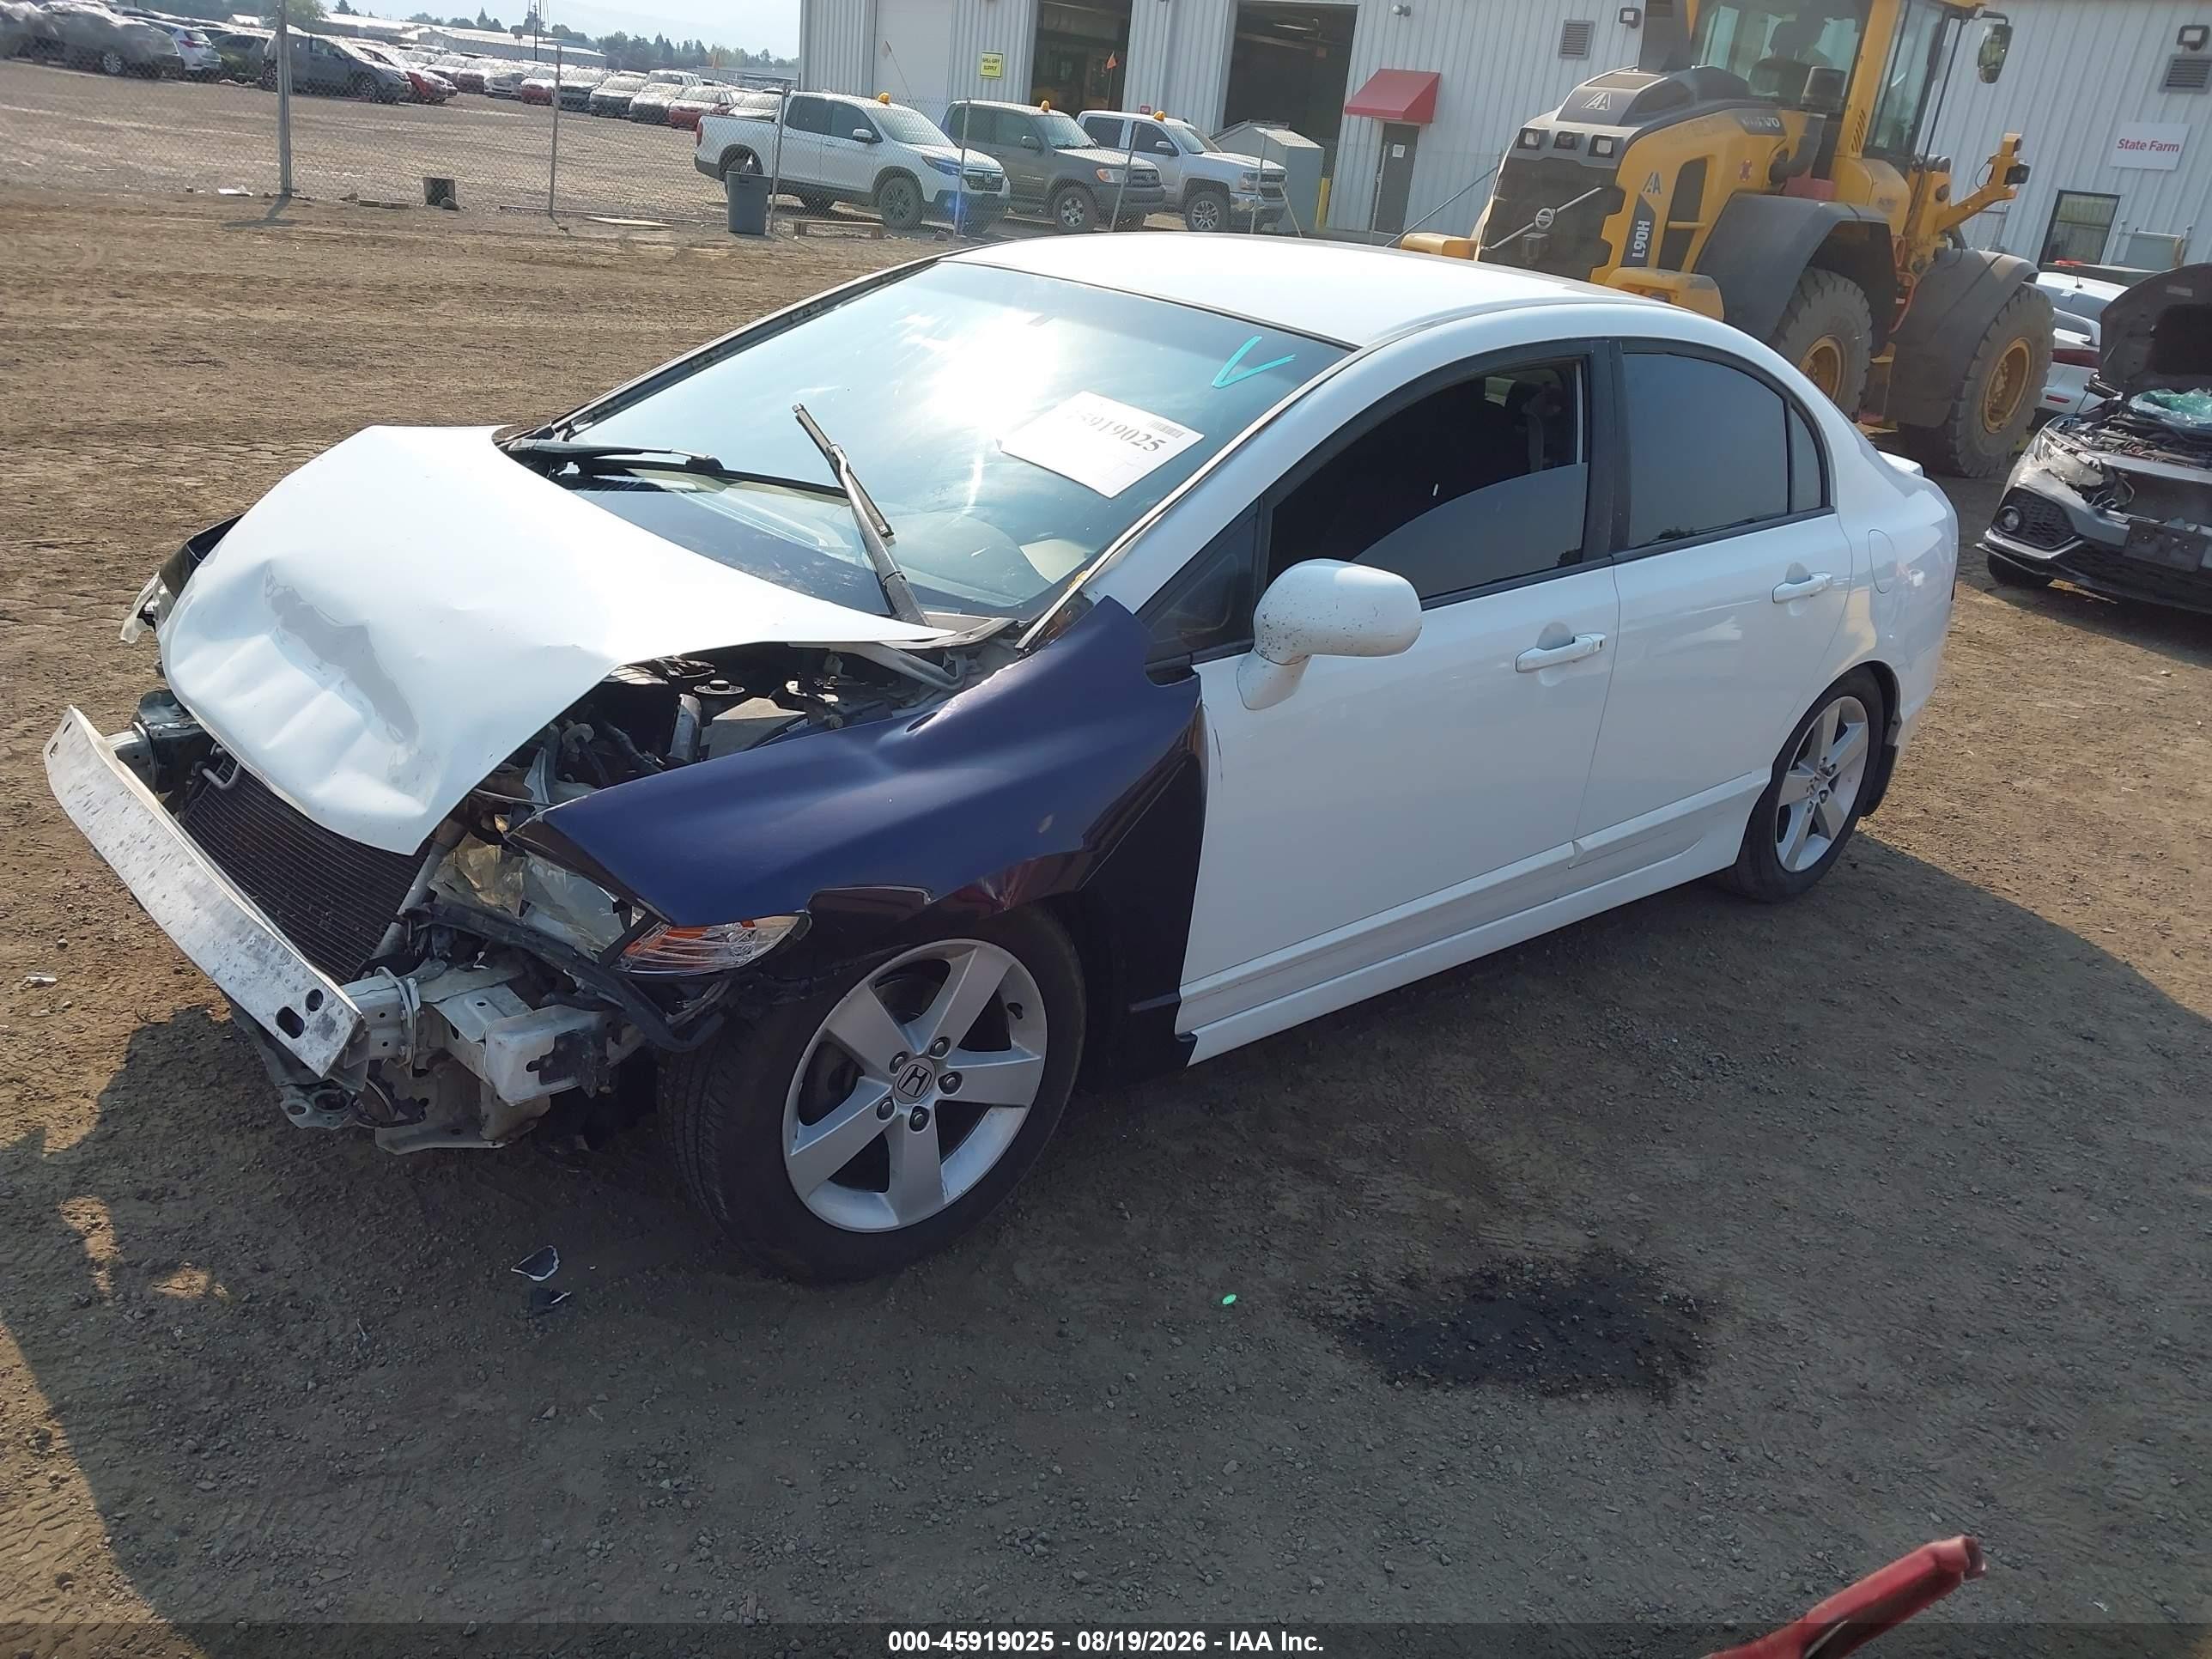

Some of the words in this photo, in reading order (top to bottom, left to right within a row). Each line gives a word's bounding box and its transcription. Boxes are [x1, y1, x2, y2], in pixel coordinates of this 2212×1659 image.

[2117, 138, 2147, 151] State
[2148, 140, 2180, 153] Farm
[1632, 220, 1650, 258] L90H
[1065, 408, 1166, 452] 919025
